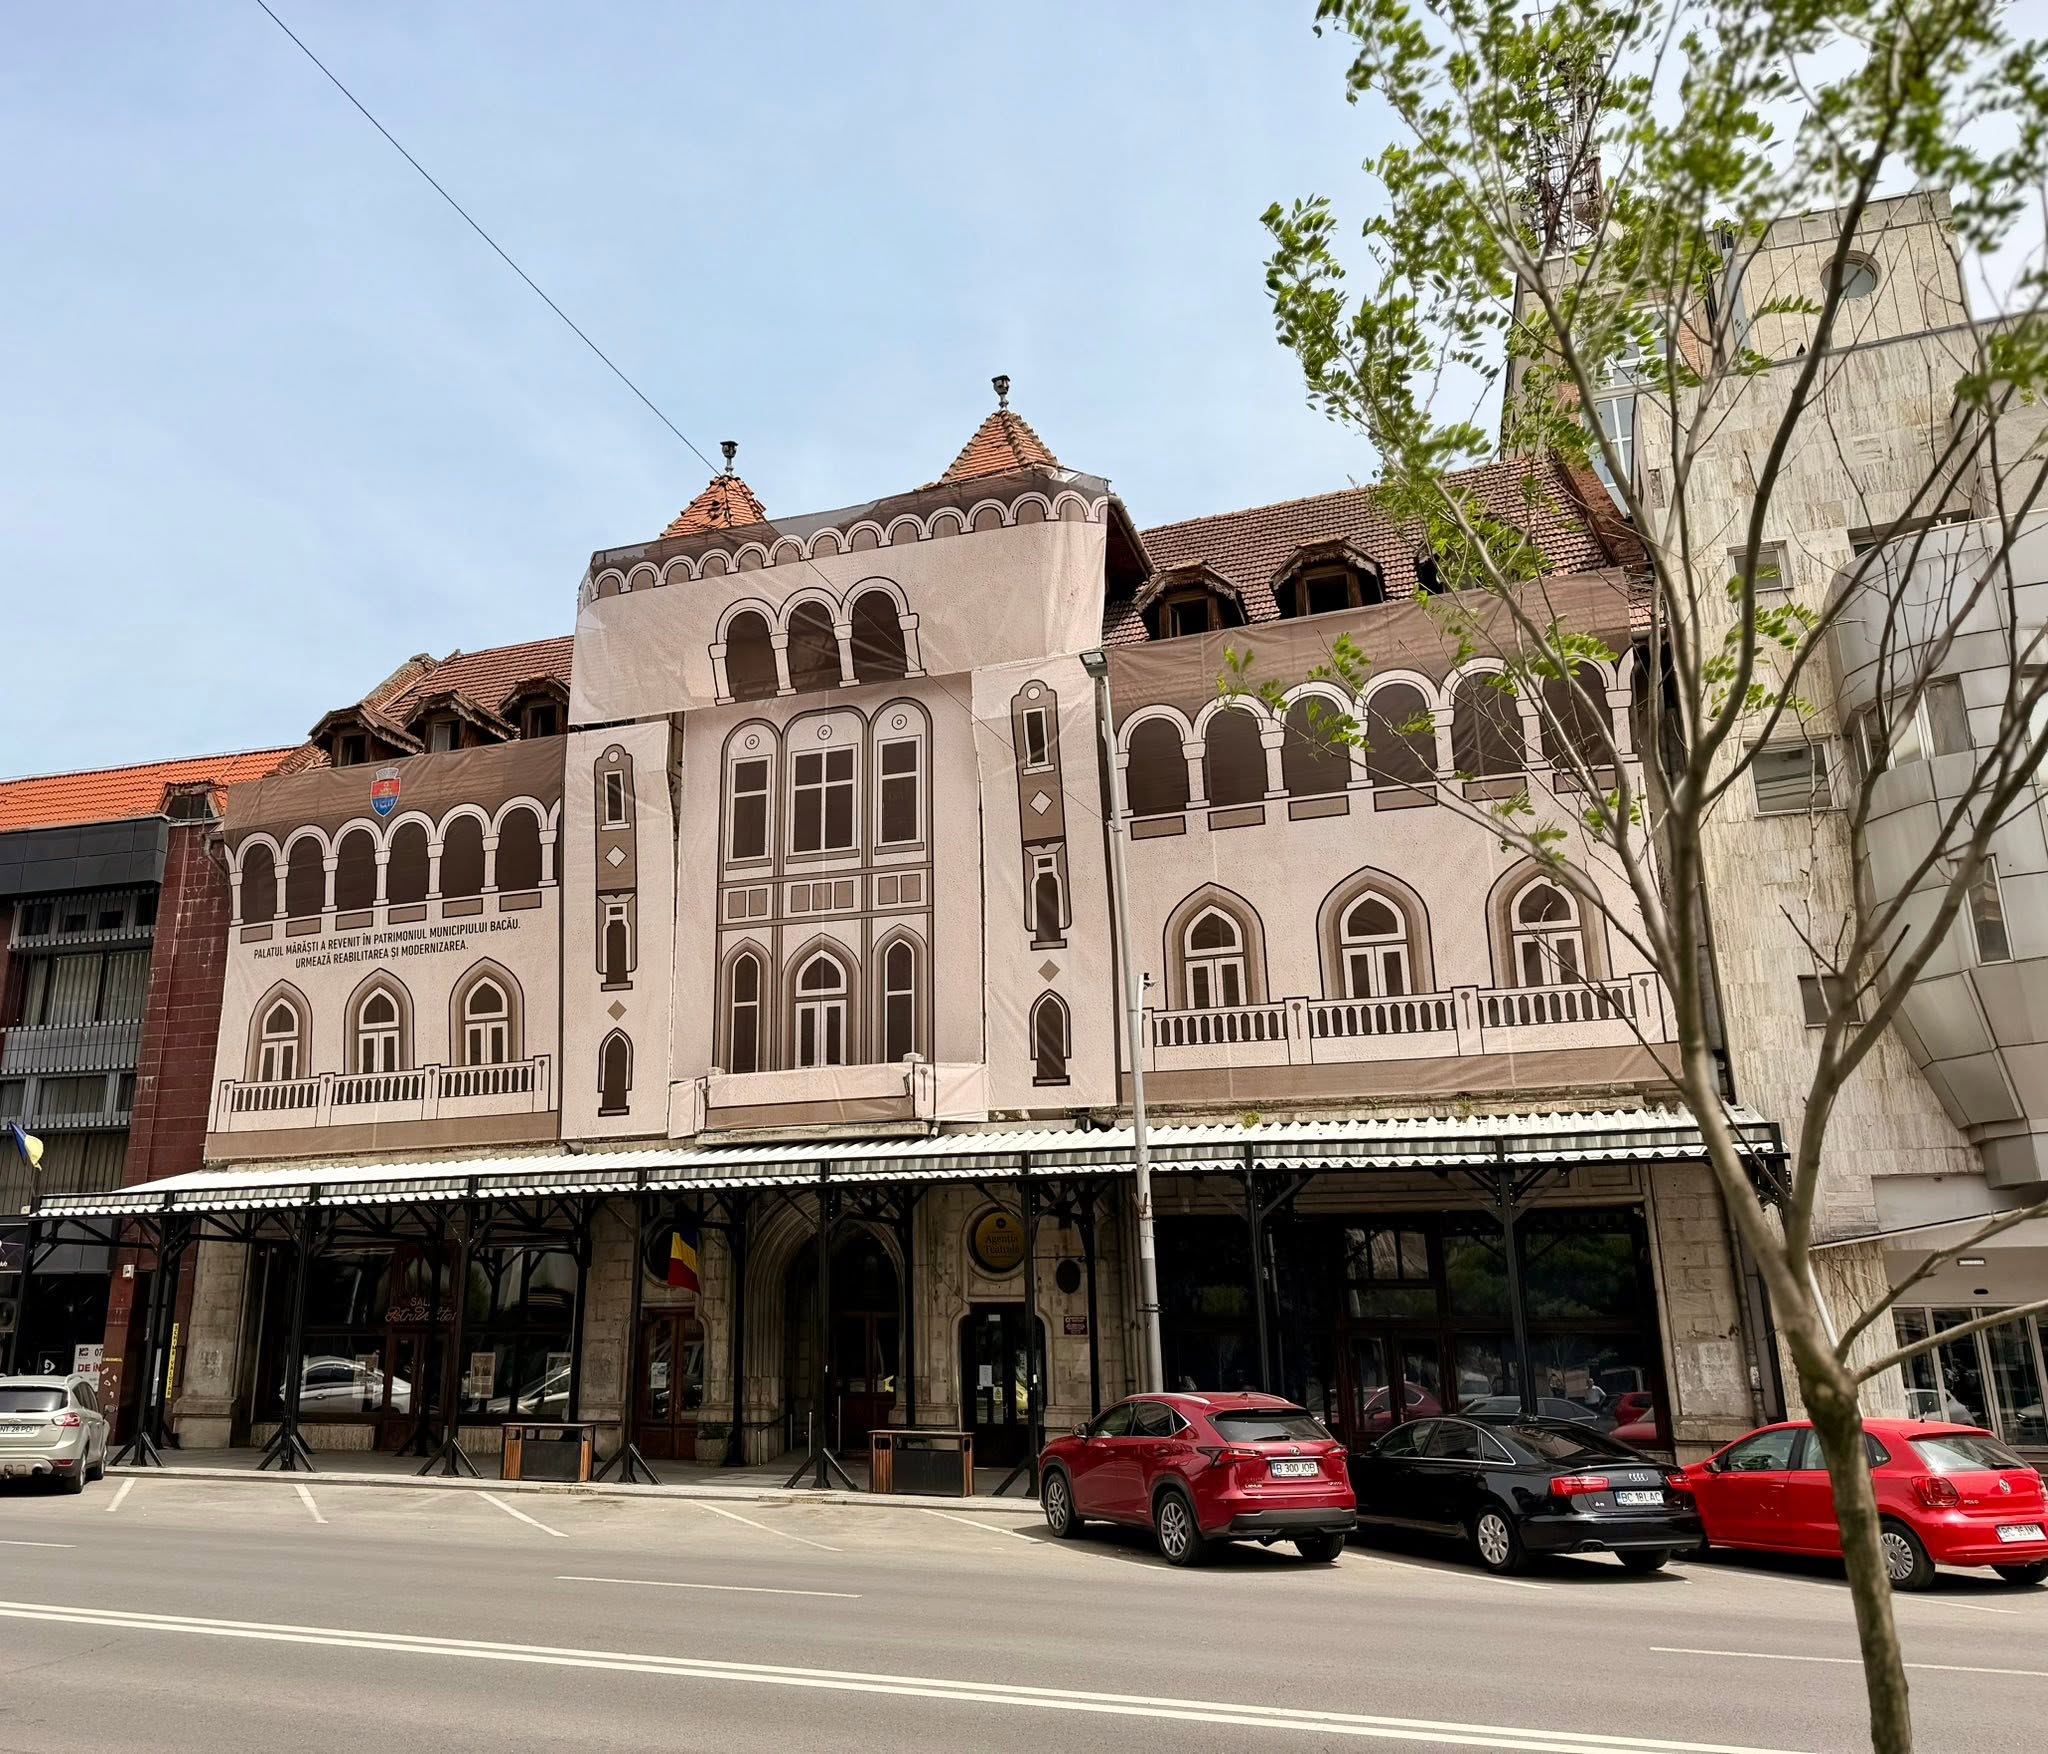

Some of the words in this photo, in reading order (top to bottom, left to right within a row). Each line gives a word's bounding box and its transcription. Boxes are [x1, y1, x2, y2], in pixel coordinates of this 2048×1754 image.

[254, 946, 283, 959] PALATUL
[286, 941, 319, 955] MĂRĂȘTI
[320, 940, 326, 951] A
[328, 938, 360, 950] REVENIT
[362, 932, 371, 946] ÎN
[374, 928, 427, 944] PATRIMONIUL
[429, 921, 488, 938] MUNICIPIULUI
[490, 916, 521, 932] BACĂU.
[295, 952, 331, 968] URMEAZĂ
[333, 947, 389, 964] REABILITAREA
[391, 946, 399, 960] ȘI
[401, 939, 469, 957] MODERNIZAREA.
[410, 1297, 431, 1307] SAL
[77, 1363, 91, 1373] DE
[1275, 1463, 1282, 1473] B
[1285, 1463, 1299, 1473] 300
[1300, 1463, 1316, 1473] JOB
[1621, 1491, 1633, 1503] BC
